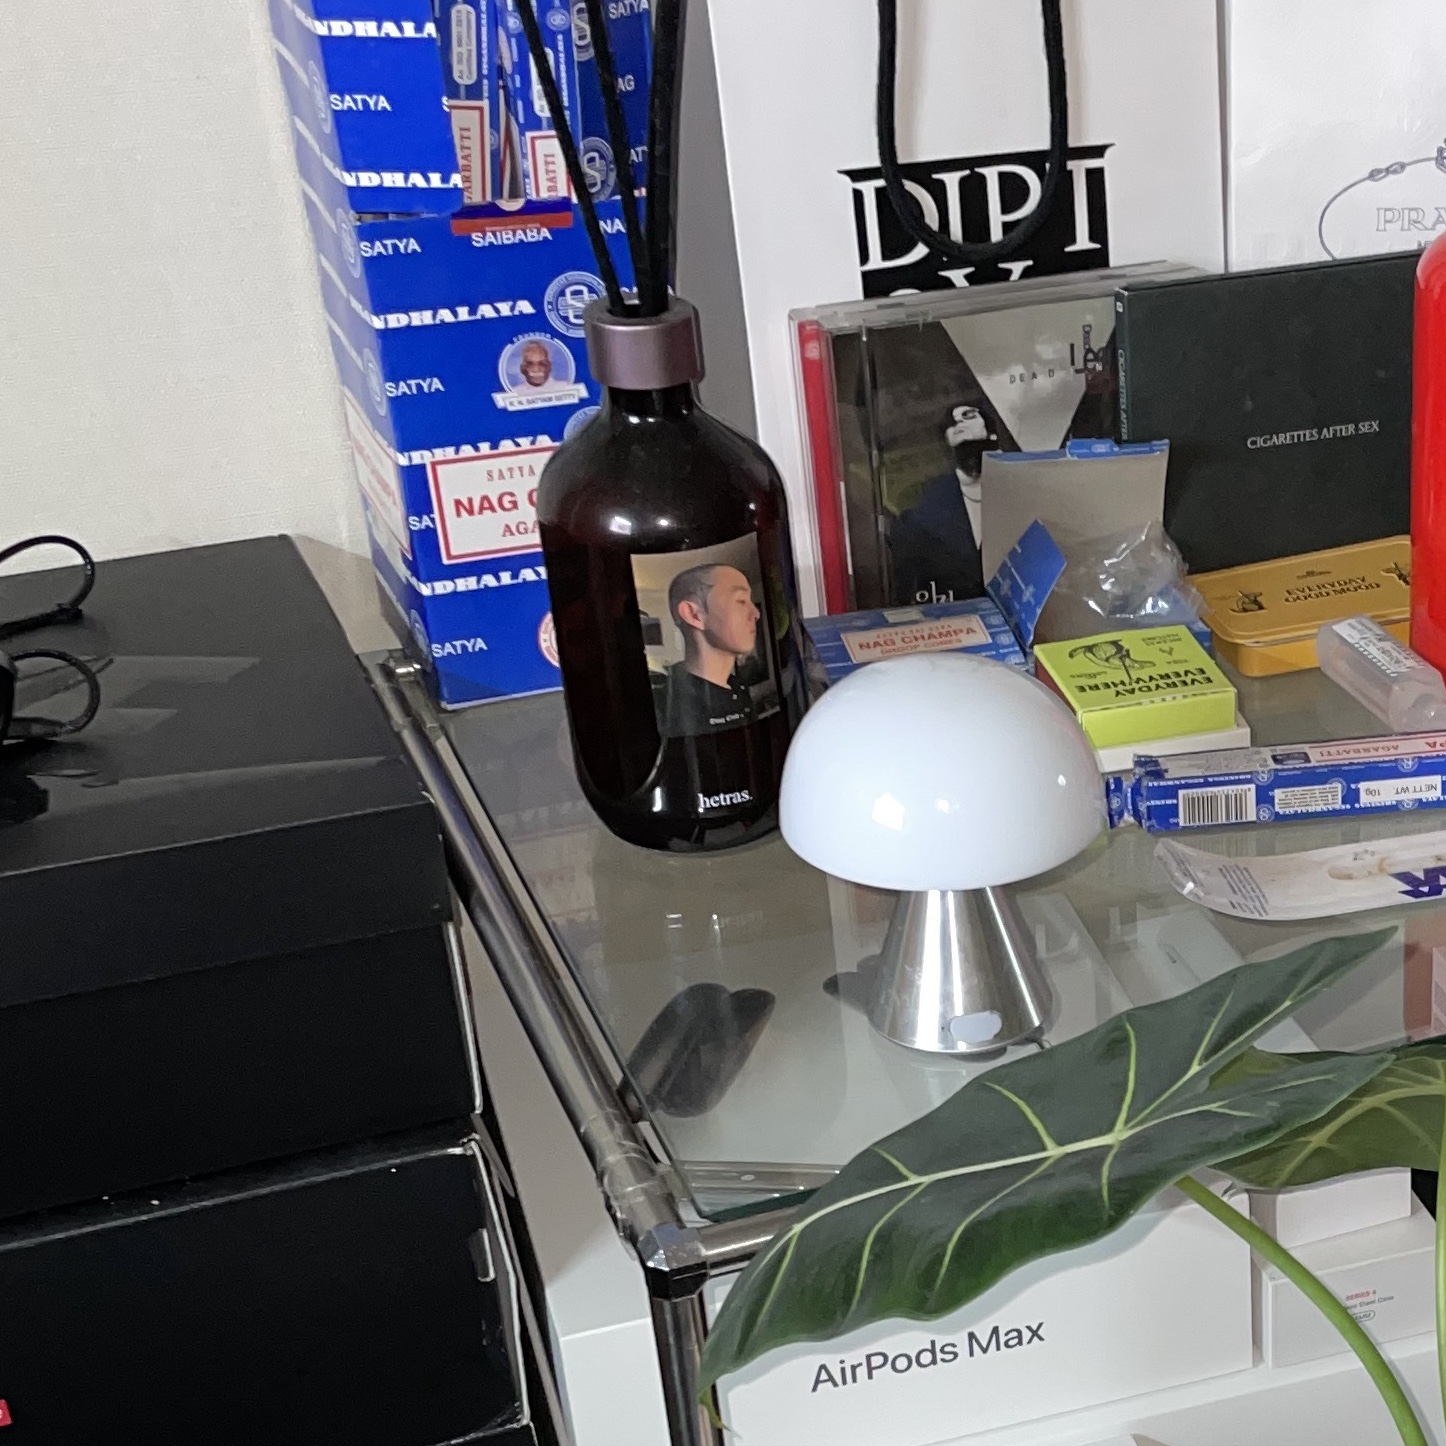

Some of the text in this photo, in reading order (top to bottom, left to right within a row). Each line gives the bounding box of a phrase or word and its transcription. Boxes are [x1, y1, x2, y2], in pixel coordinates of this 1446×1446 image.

[329, 94, 392, 112] SATYA
[360, 237, 422, 258] SATYA
[471, 227, 553, 248] SAIBABA
[385, 377, 445, 398] SATYA
[1247, 420, 1380, 450] CIGARETTES AFTER SEX
[486, 464, 536, 482] SATYA
[454, 490, 519, 518] NAG
[1284, 582, 1381, 604] GOOD MOOD
[1285, 576, 1367, 596] EVERYDAY
[431, 637, 488, 658] SATYA
[1074, 666, 1207, 695] EVERYWHERE
[1114, 675, 1213, 699] EVERYDAY
[1365, 786, 1383, 799] 10g
[1416, 781, 1438, 796] NETT
[811, 1319, 1046, 1392] AirPods Max
